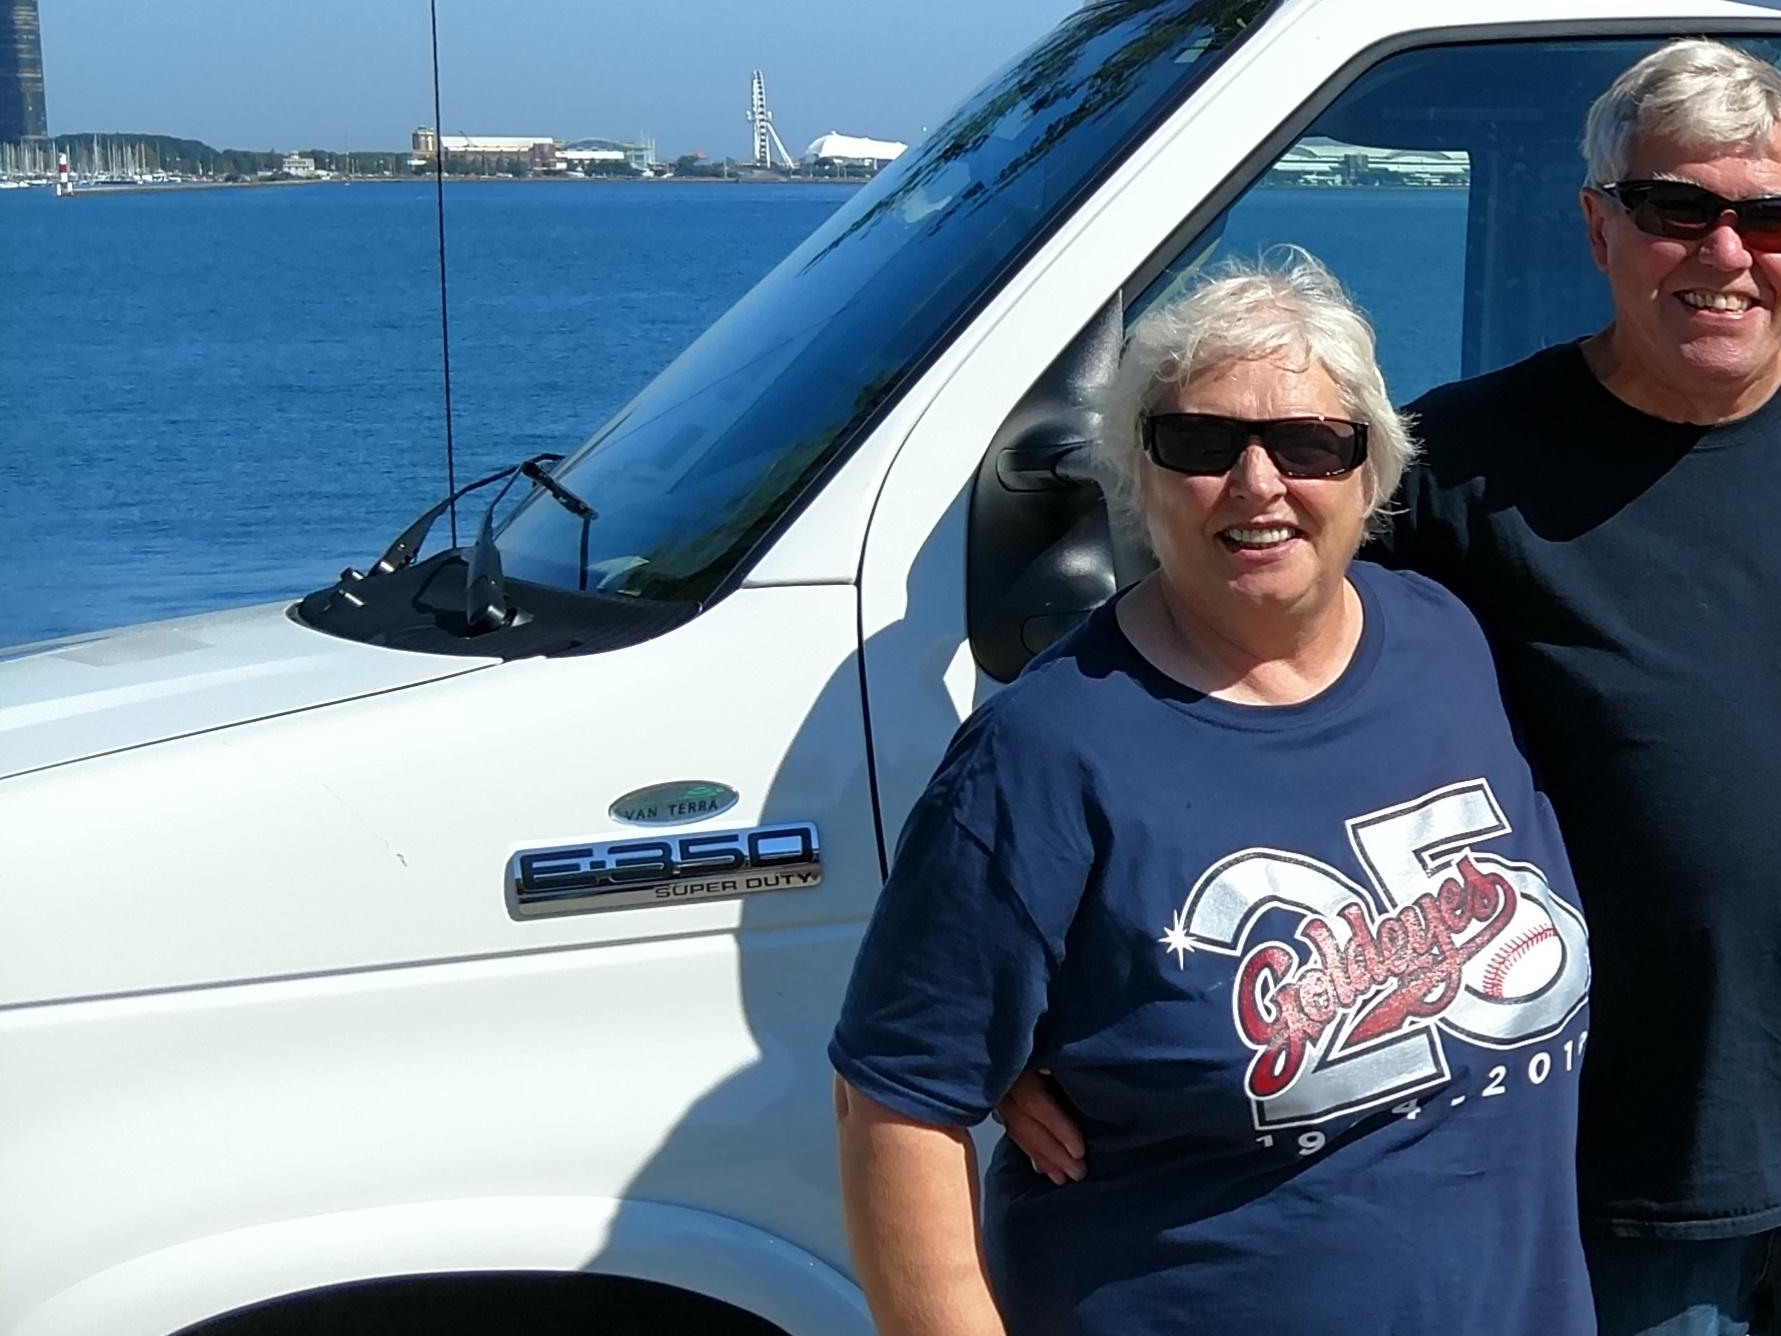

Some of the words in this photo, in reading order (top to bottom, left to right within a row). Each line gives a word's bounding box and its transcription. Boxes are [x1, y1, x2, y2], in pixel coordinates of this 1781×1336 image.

[624, 807, 658, 821] VAN
[668, 799, 719, 816] TERRA
[655, 880, 737, 898] SUPER
[746, 872, 812, 889] DUTY
[1236, 852, 1518, 1095] Goldeyes
